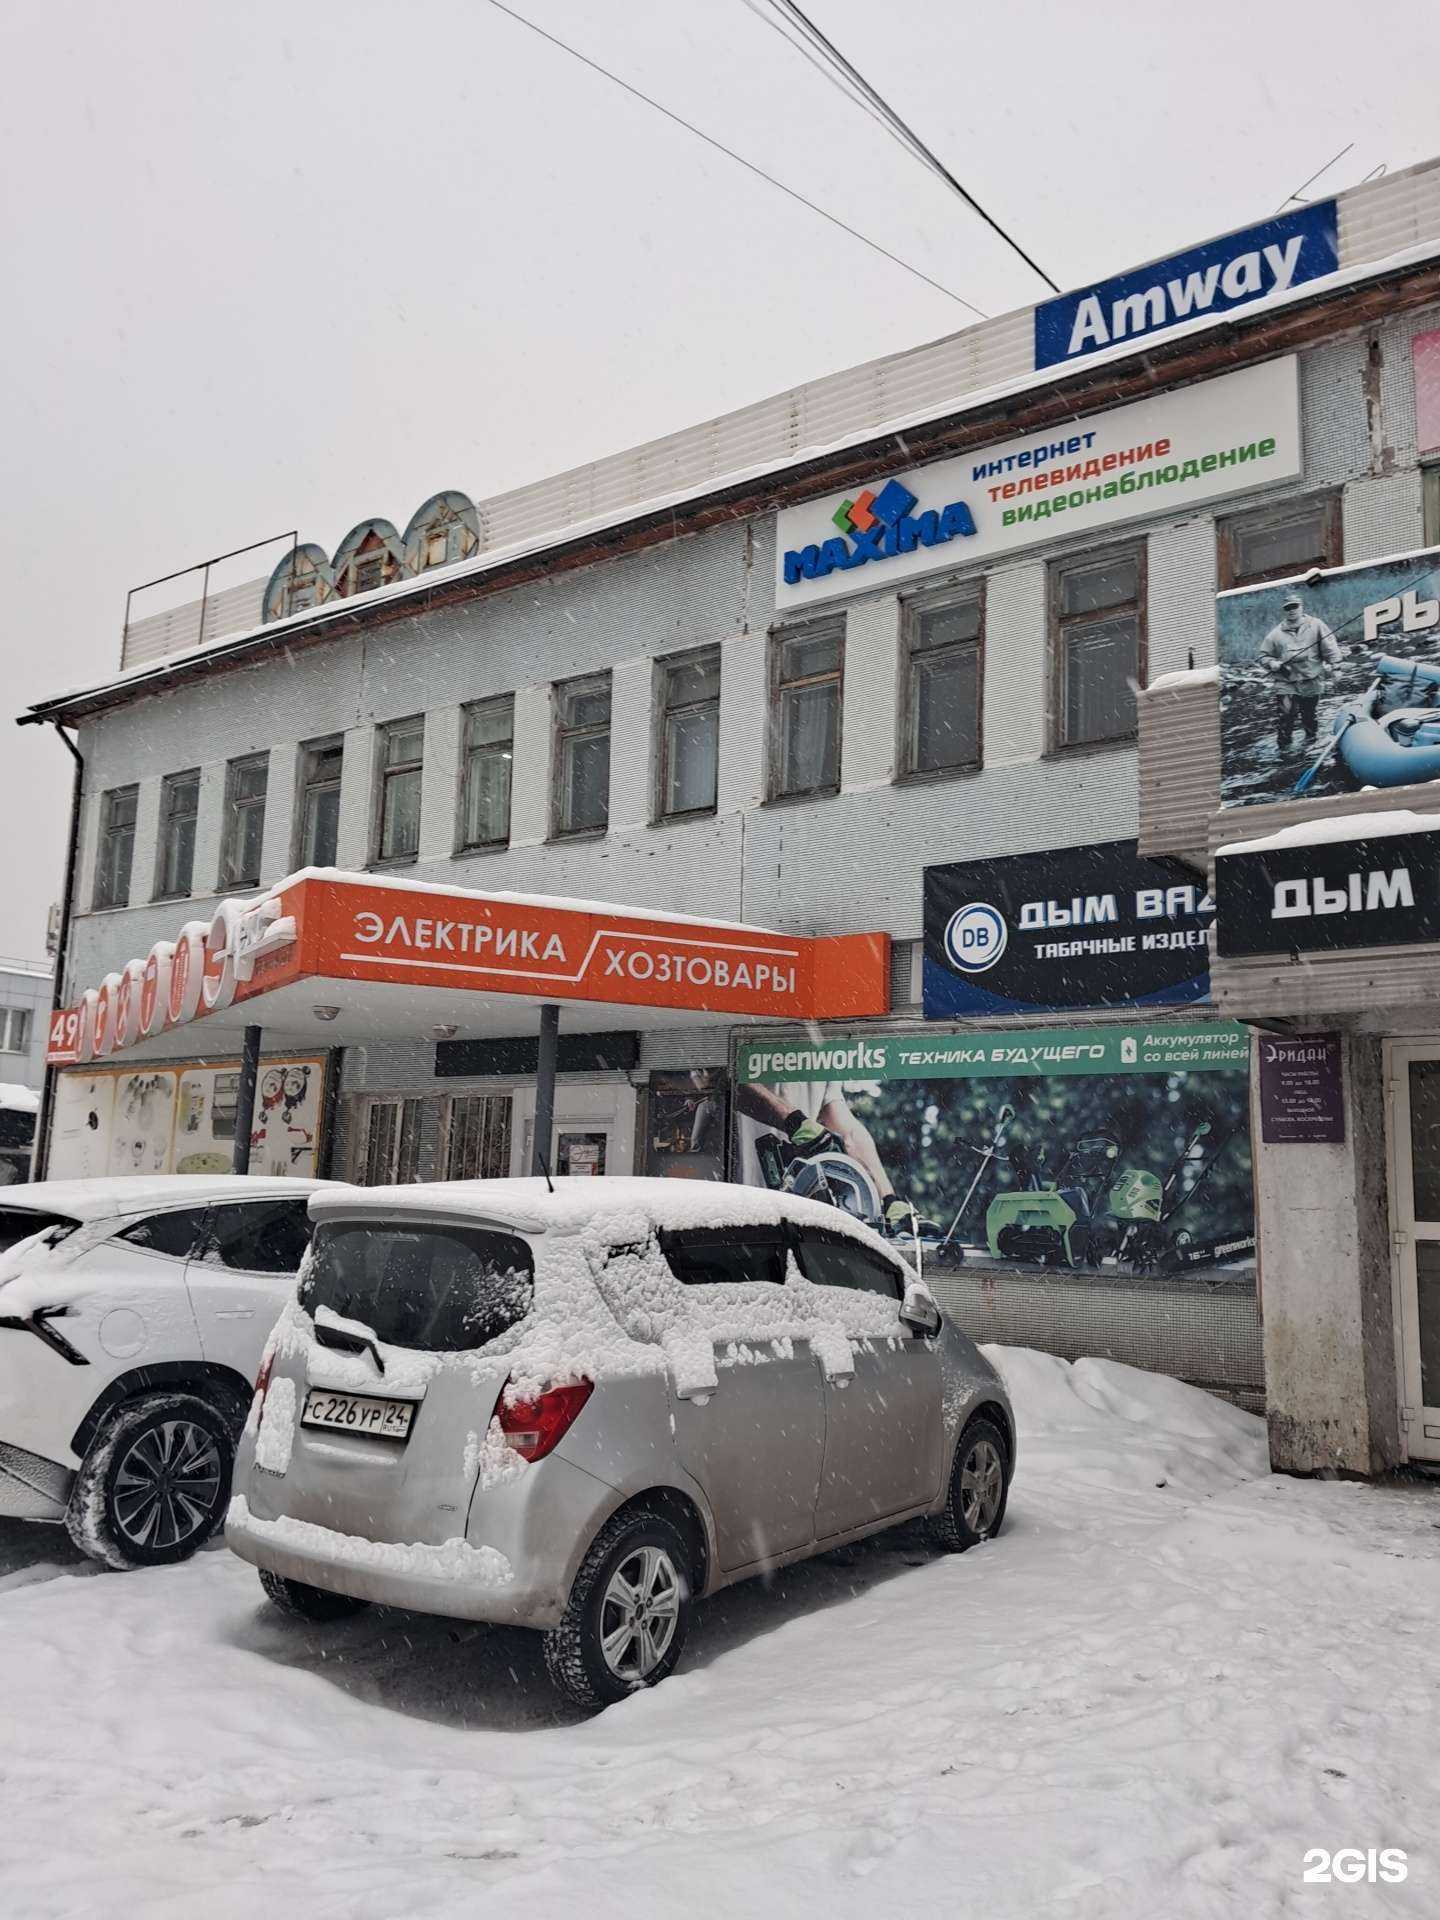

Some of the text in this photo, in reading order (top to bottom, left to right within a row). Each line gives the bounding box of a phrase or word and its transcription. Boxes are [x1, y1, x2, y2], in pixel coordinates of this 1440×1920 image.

[1066, 235, 1303, 354] Amway
[972, 431, 1097, 482] интернет
[987, 438, 1171, 503] телевидение
[1001, 438, 1277, 527] видеонаблюдение
[1018, 893, 1119, 931] ДЫМ
[1271, 868, 1416, 919] ДЫМ
[354, 910, 568, 963] ЭЛЕКТРИКА
[961, 926, 990, 949] DB
[1034, 936, 1137, 960] ТАБАЧНЫЕ
[603, 947, 796, 995] ХОЗТОВАРЫ
[50, 1013, 79, 1048] 49
[1143, 1033, 1240, 1049] Аккумулятор
[747, 1041, 886, 1079] greenworks
[898, 1044, 1105, 1065] ТЕХНИКА БУДУЩЕГО
[1143, 1050, 1161, 1062] со
[1165, 1047, 1199, 1061] всей
